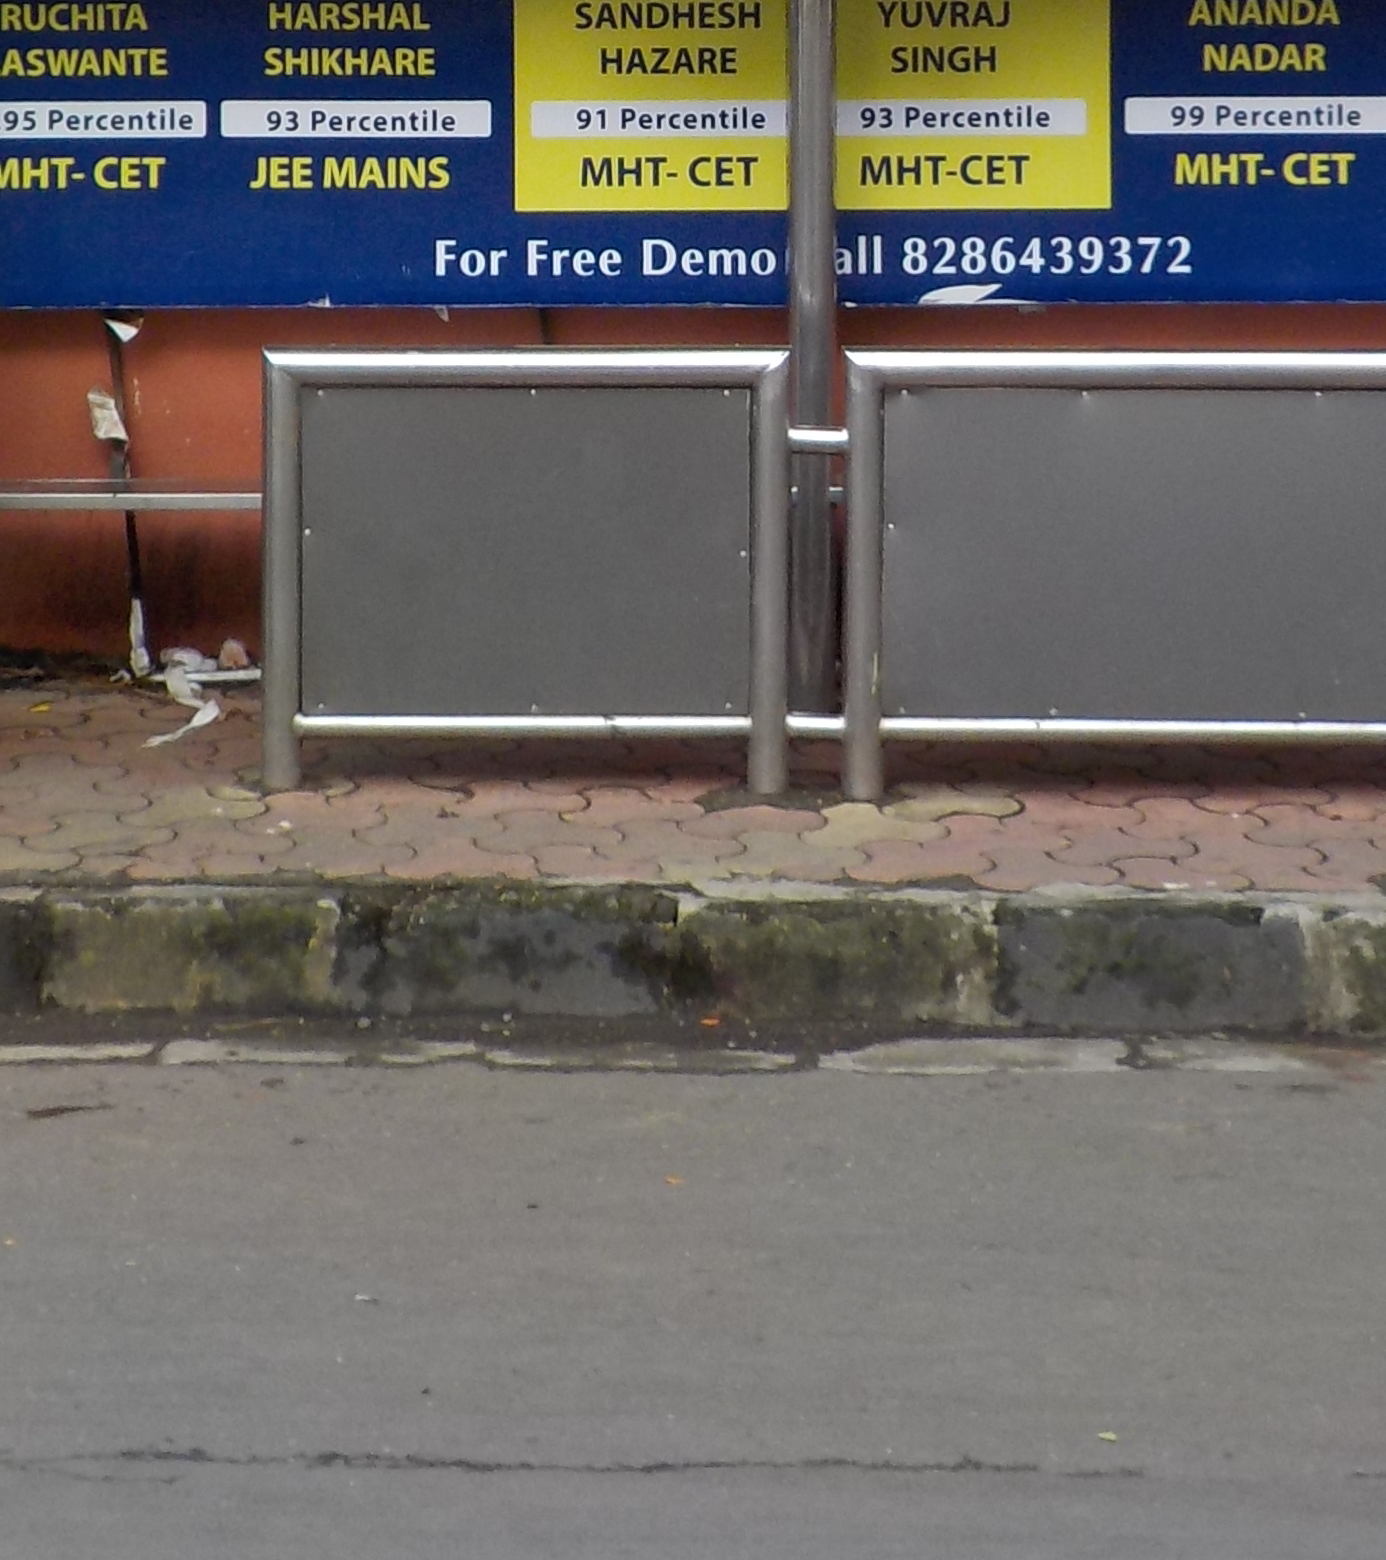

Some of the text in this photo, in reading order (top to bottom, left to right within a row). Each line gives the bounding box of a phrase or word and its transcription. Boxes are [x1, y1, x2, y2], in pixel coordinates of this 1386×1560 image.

[0, 2, 148, 32] RUCHITA
[267, 2, 431, 31] HARSHAL
[574, 1, 761, 30] SANDHESH
[877, 0, 1011, 29] YUVRAJ
[263, 47, 437, 76] SHIKHARE
[600, 47, 738, 75] HAZARE
[890, 45, 997, 73] SINGH
[1202, 43, 1326, 71] NADAR
[47, 108, 194, 133] Percentile
[266, 108, 456, 133] 93 Percentile
[575, 106, 766, 131] 91 Percentile
[859, 105, 1051, 130] 93 Percentile
[1170, 104, 1362, 129] 99 Percentile
[250, 156, 451, 189] JEE MAINS
[859, 154, 1031, 187] MHT-CET
[433, 239, 508, 276] For
[525, 238, 623, 276] Free
[642, 238, 777, 276] Demo
[901, 235, 1193, 275] 8286439372
